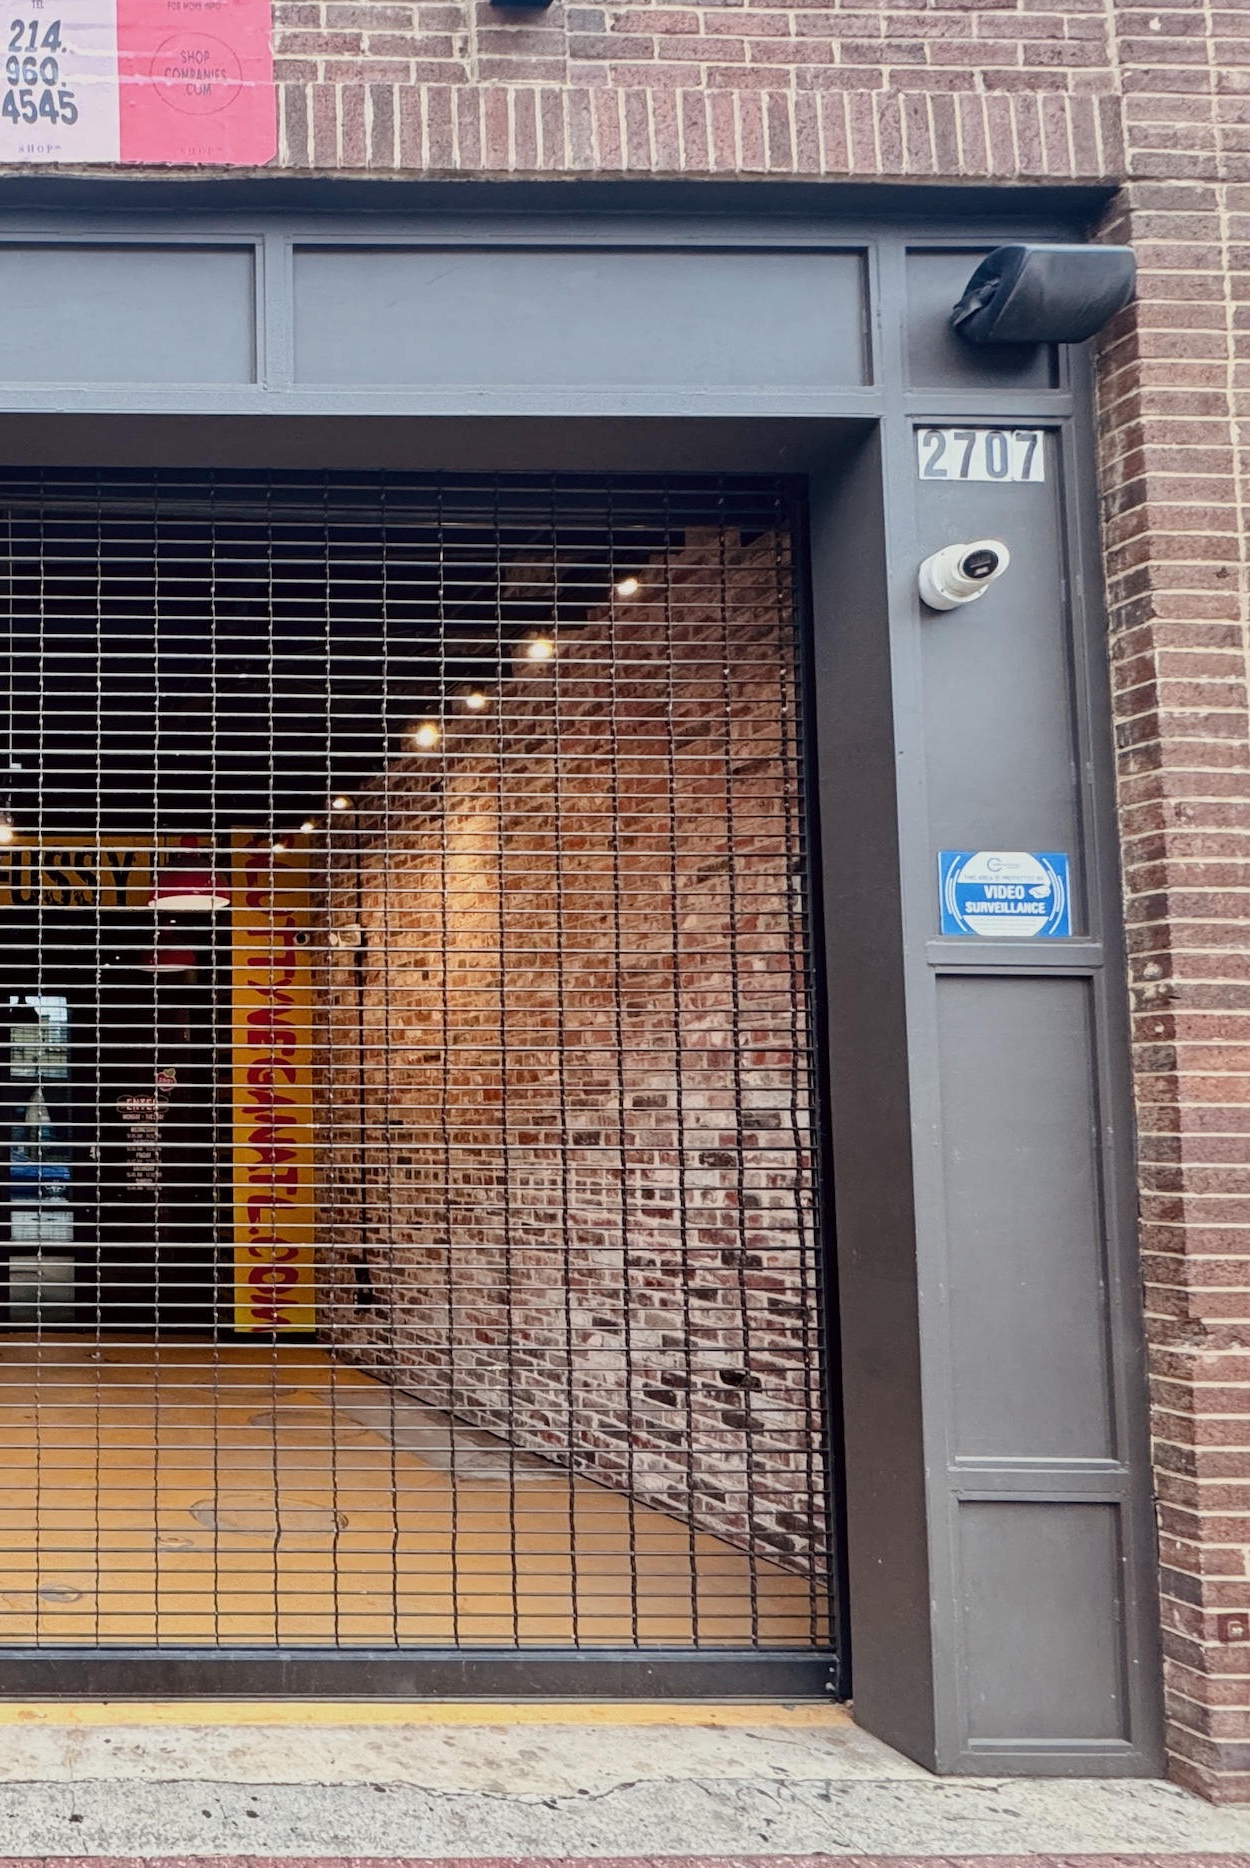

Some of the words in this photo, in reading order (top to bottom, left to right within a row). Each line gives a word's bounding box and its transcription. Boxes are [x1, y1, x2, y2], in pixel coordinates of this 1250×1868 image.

[31, 0, 45, 10] TEL
[7, 18, 68, 54] 214.
[180, 50, 210, 64] SHOP
[5, 55, 67, 88] 960.
[1, 88, 79, 125] 4545
[922, 430, 1040, 482] 2707
[984, 885, 1025, 900] VIDEO
[965, 901, 1046, 914] SURVEILLANCE
